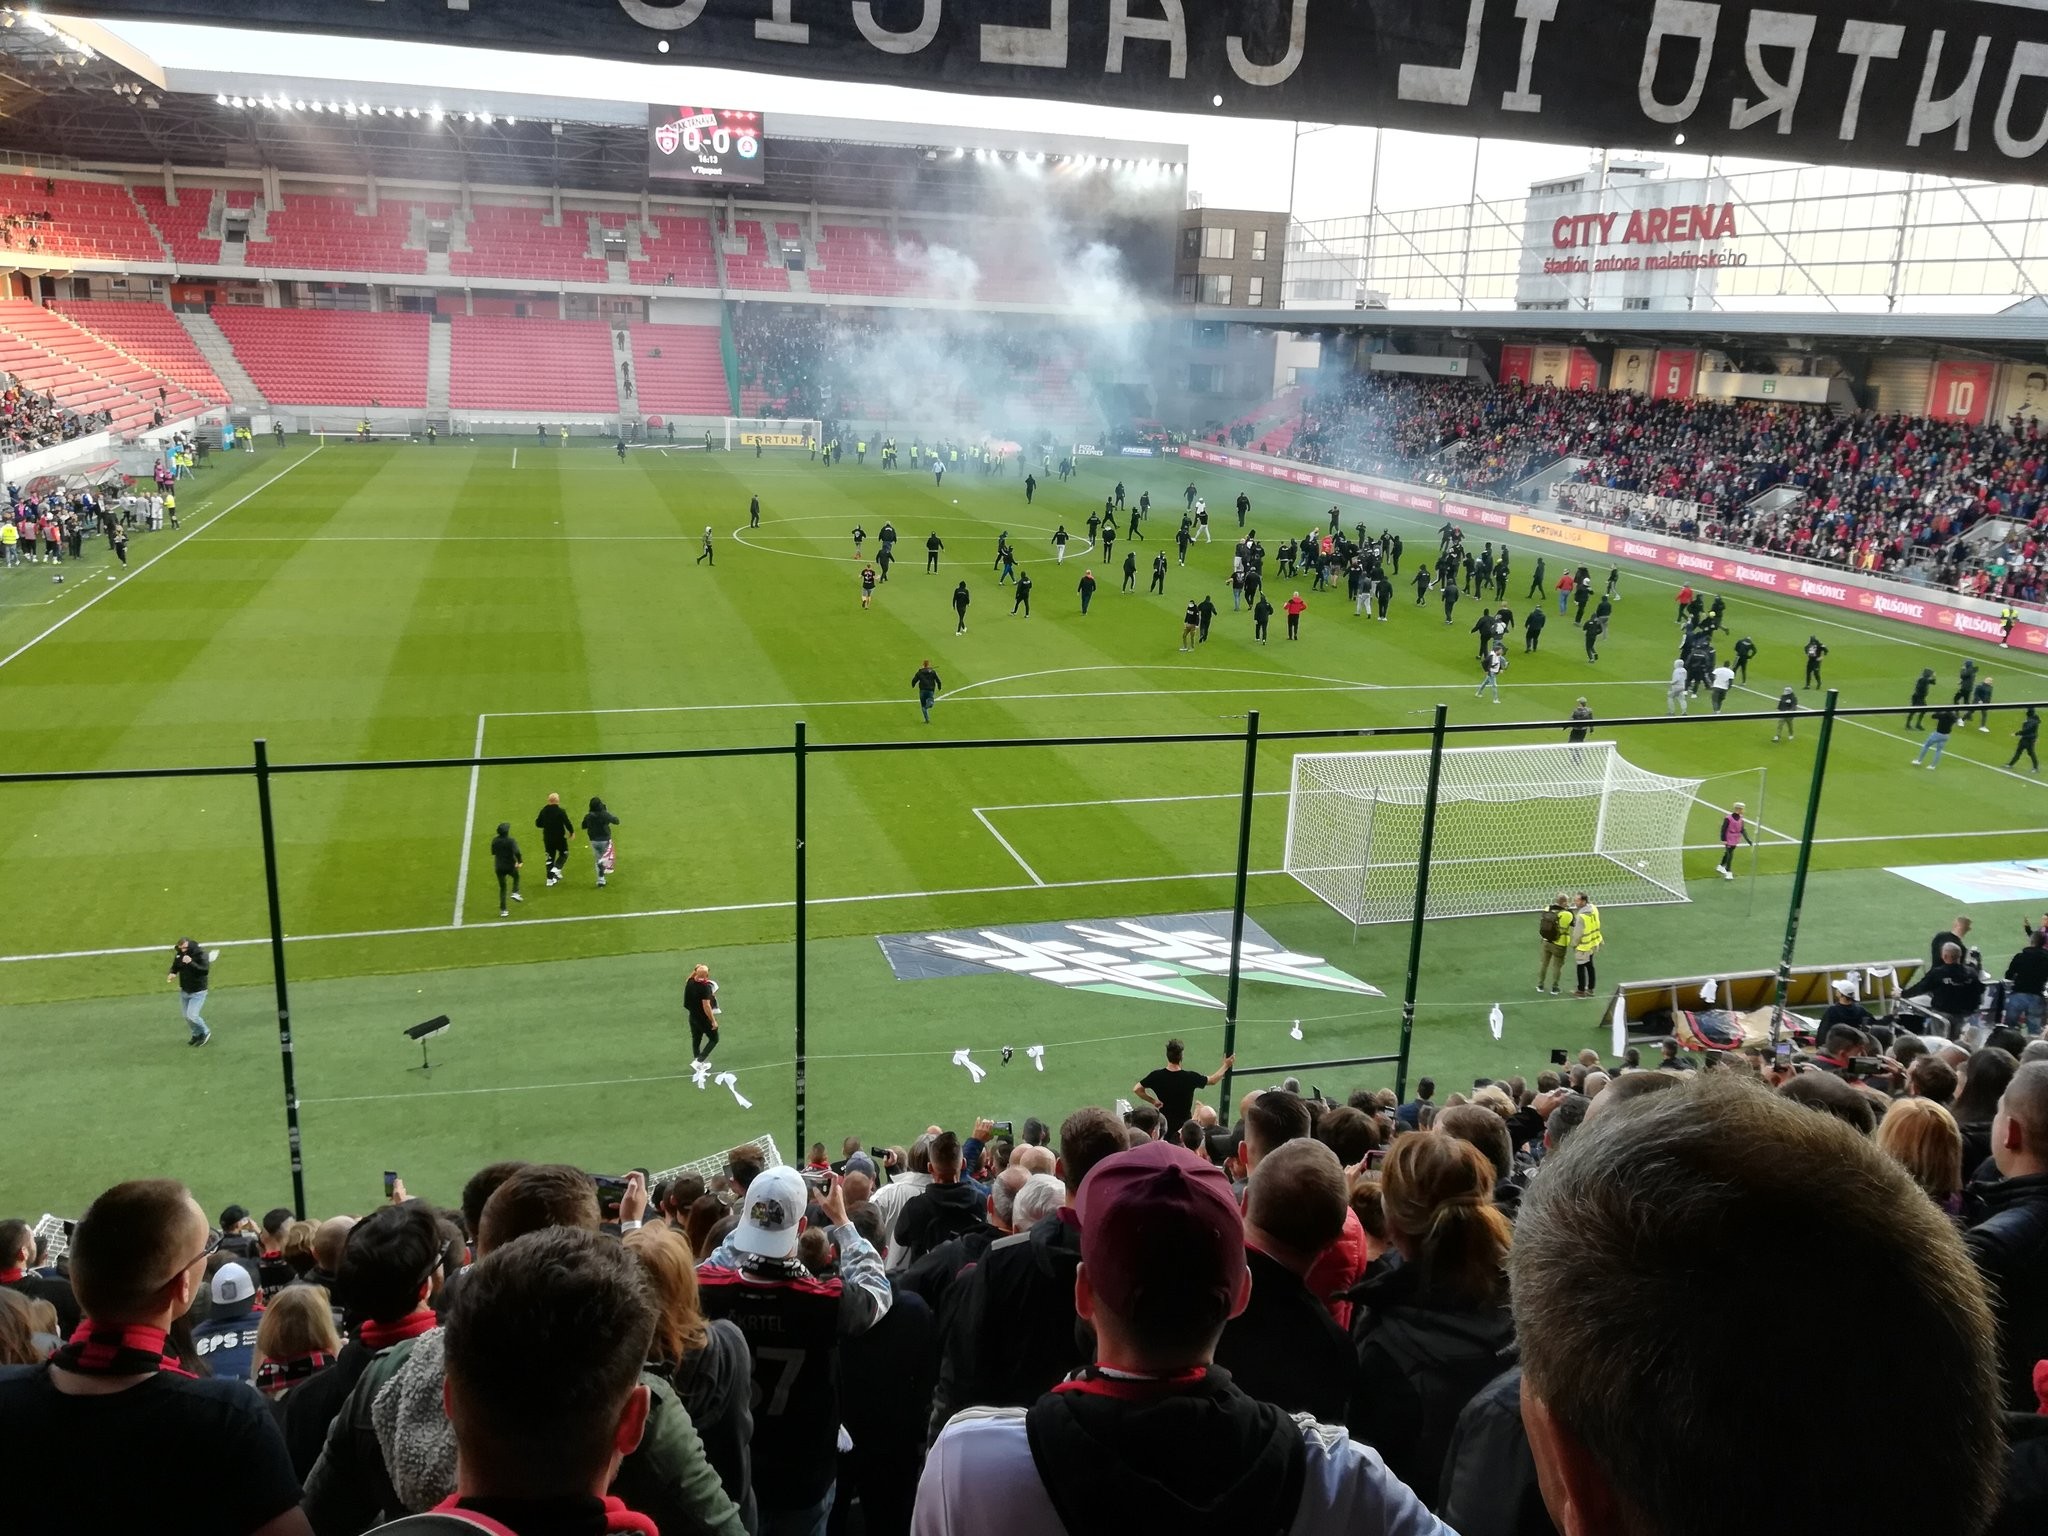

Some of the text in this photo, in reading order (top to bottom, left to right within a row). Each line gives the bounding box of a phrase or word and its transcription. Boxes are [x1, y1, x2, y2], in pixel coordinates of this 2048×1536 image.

[1552, 202, 1737, 249] CITY ARENA
[1543, 248, 1748, 274] štadión antona malatinského
[1667, 366, 1681, 394] 9
[1948, 381, 1974, 416] 10
[1677, 552, 1714, 571] KRUŠOVICE
[1735, 565, 1777, 585] KRUŠOVICE
[1800, 579, 1846, 601] KRUŠOVICE
[1873, 594, 1924, 619] KRUŠOVICE
[1953, 611, 2007, 637] KRUŠOVIC
[196, 1331, 239, 1356] EPS
[751, 1346, 807, 1416] 7
